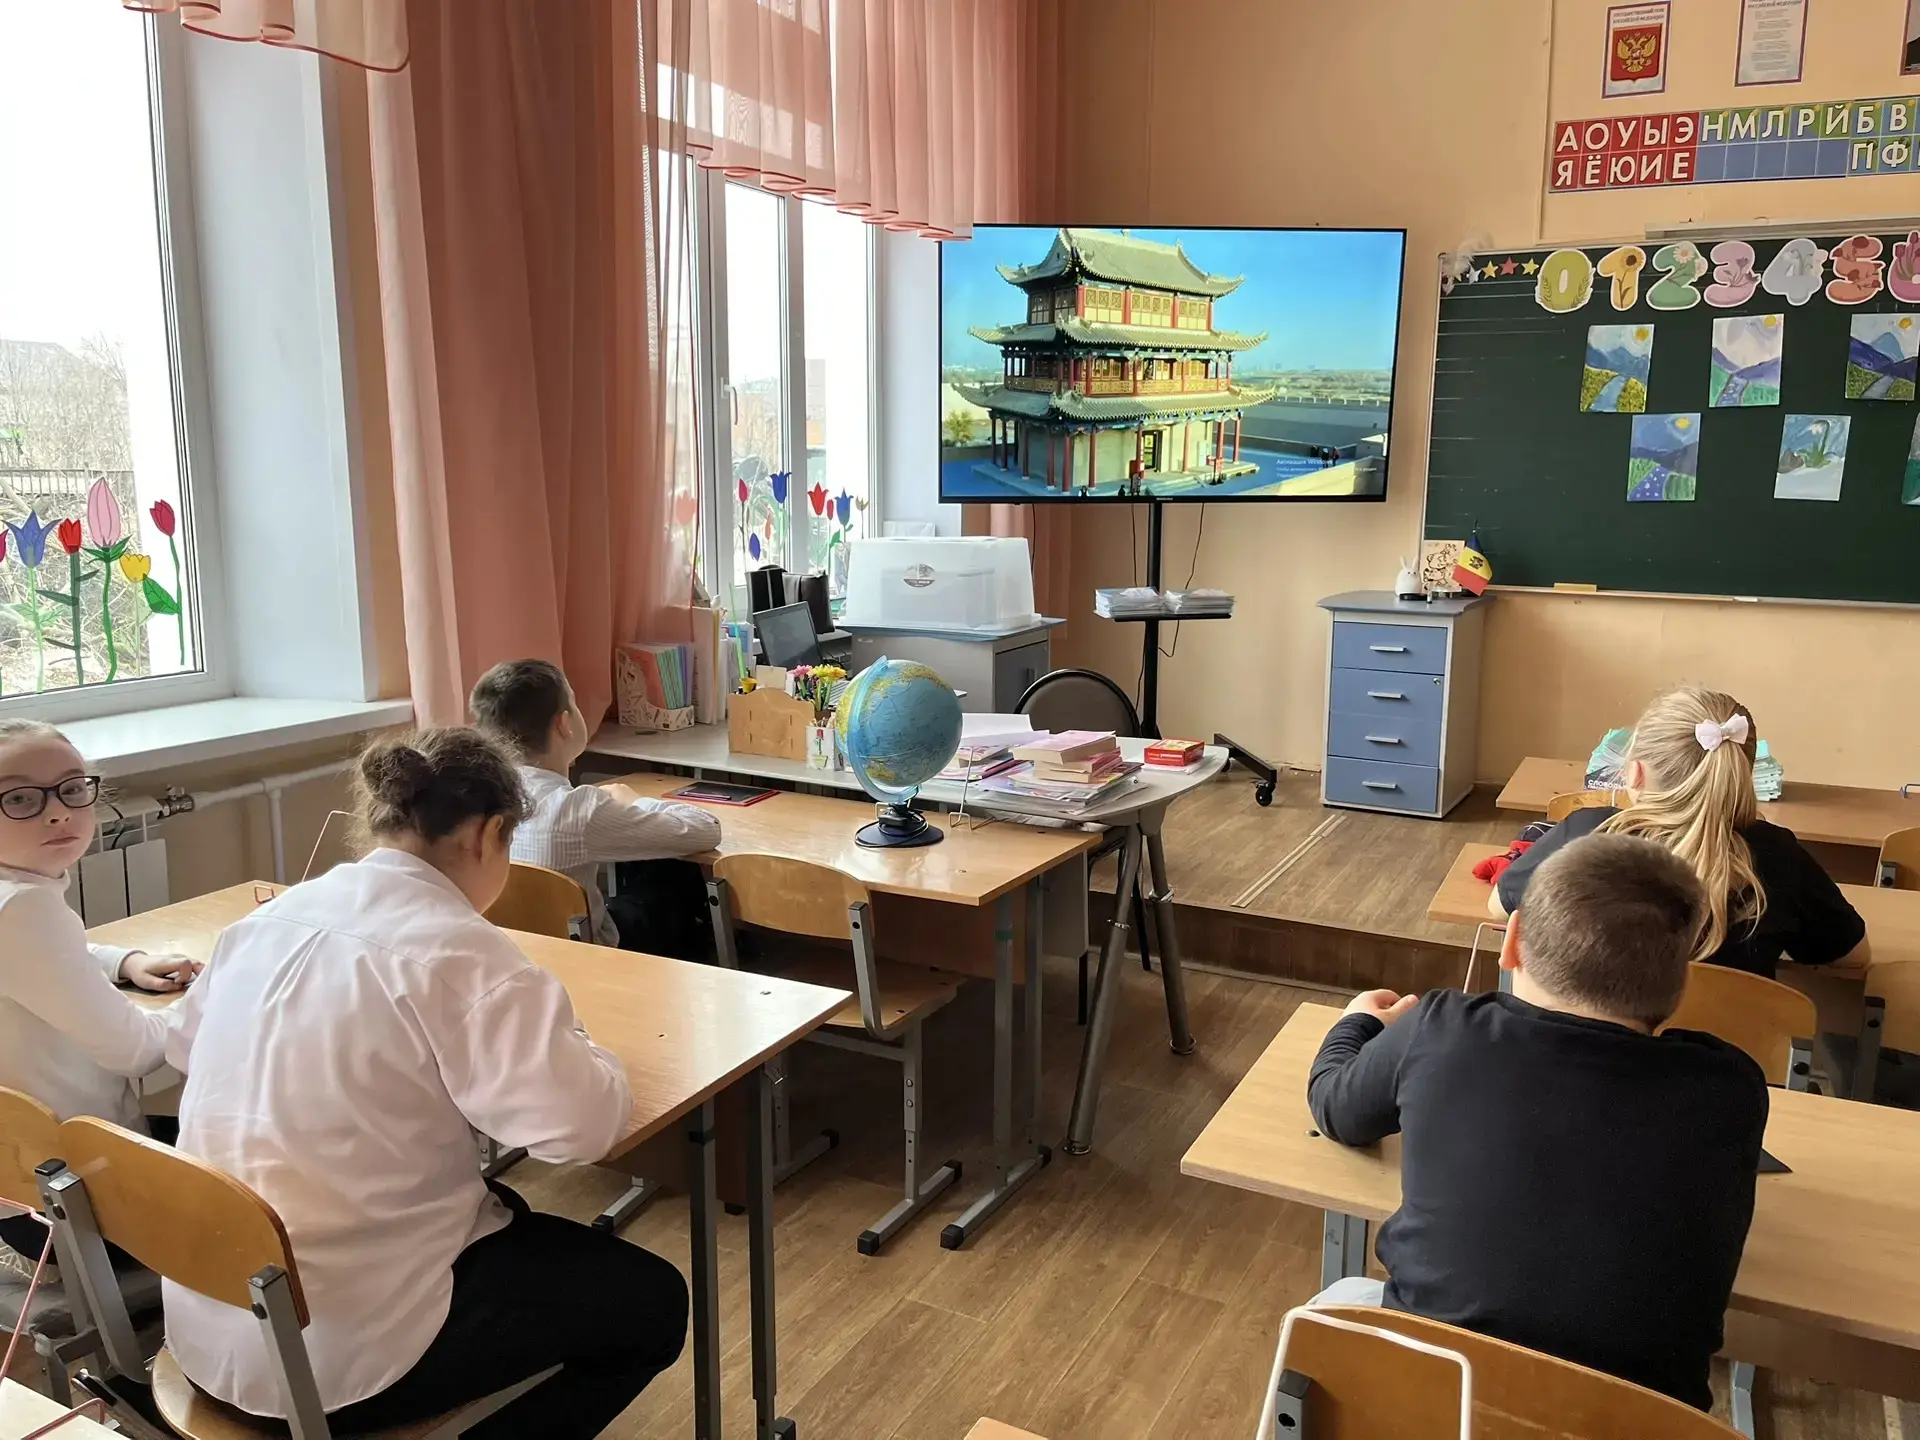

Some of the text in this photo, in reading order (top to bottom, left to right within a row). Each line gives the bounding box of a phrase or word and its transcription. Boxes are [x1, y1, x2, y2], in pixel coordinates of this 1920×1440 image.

[1535, 249, 1596, 313] 0
[1597, 245, 1646, 311] 1
[1646, 241, 1708, 310] 2
[1703, 240, 1761, 307] 3
[1762, 238, 1828, 306] 4
[1826, 233, 1886, 305] 5
